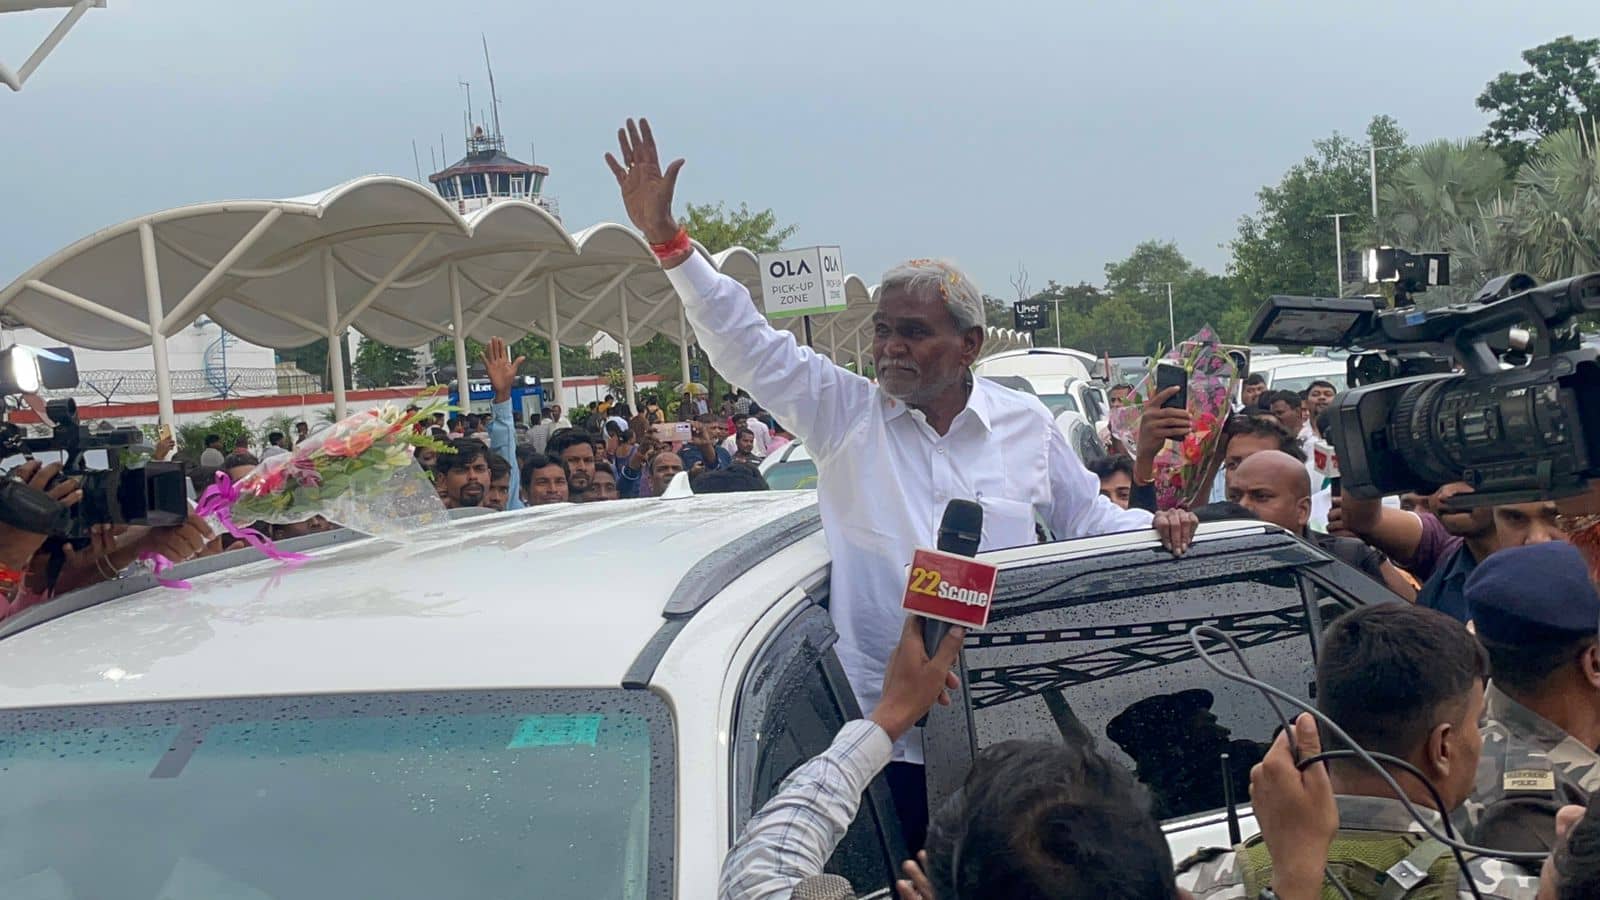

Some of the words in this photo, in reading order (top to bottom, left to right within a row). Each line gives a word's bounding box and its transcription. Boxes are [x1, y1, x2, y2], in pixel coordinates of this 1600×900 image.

[770, 260, 812, 278] OLA
[823, 256, 839, 272] OLA
[772, 281, 814, 295] PICK-UP
[781, 294, 809, 305] ZONE
[1016, 304, 1040, 314] Uber
